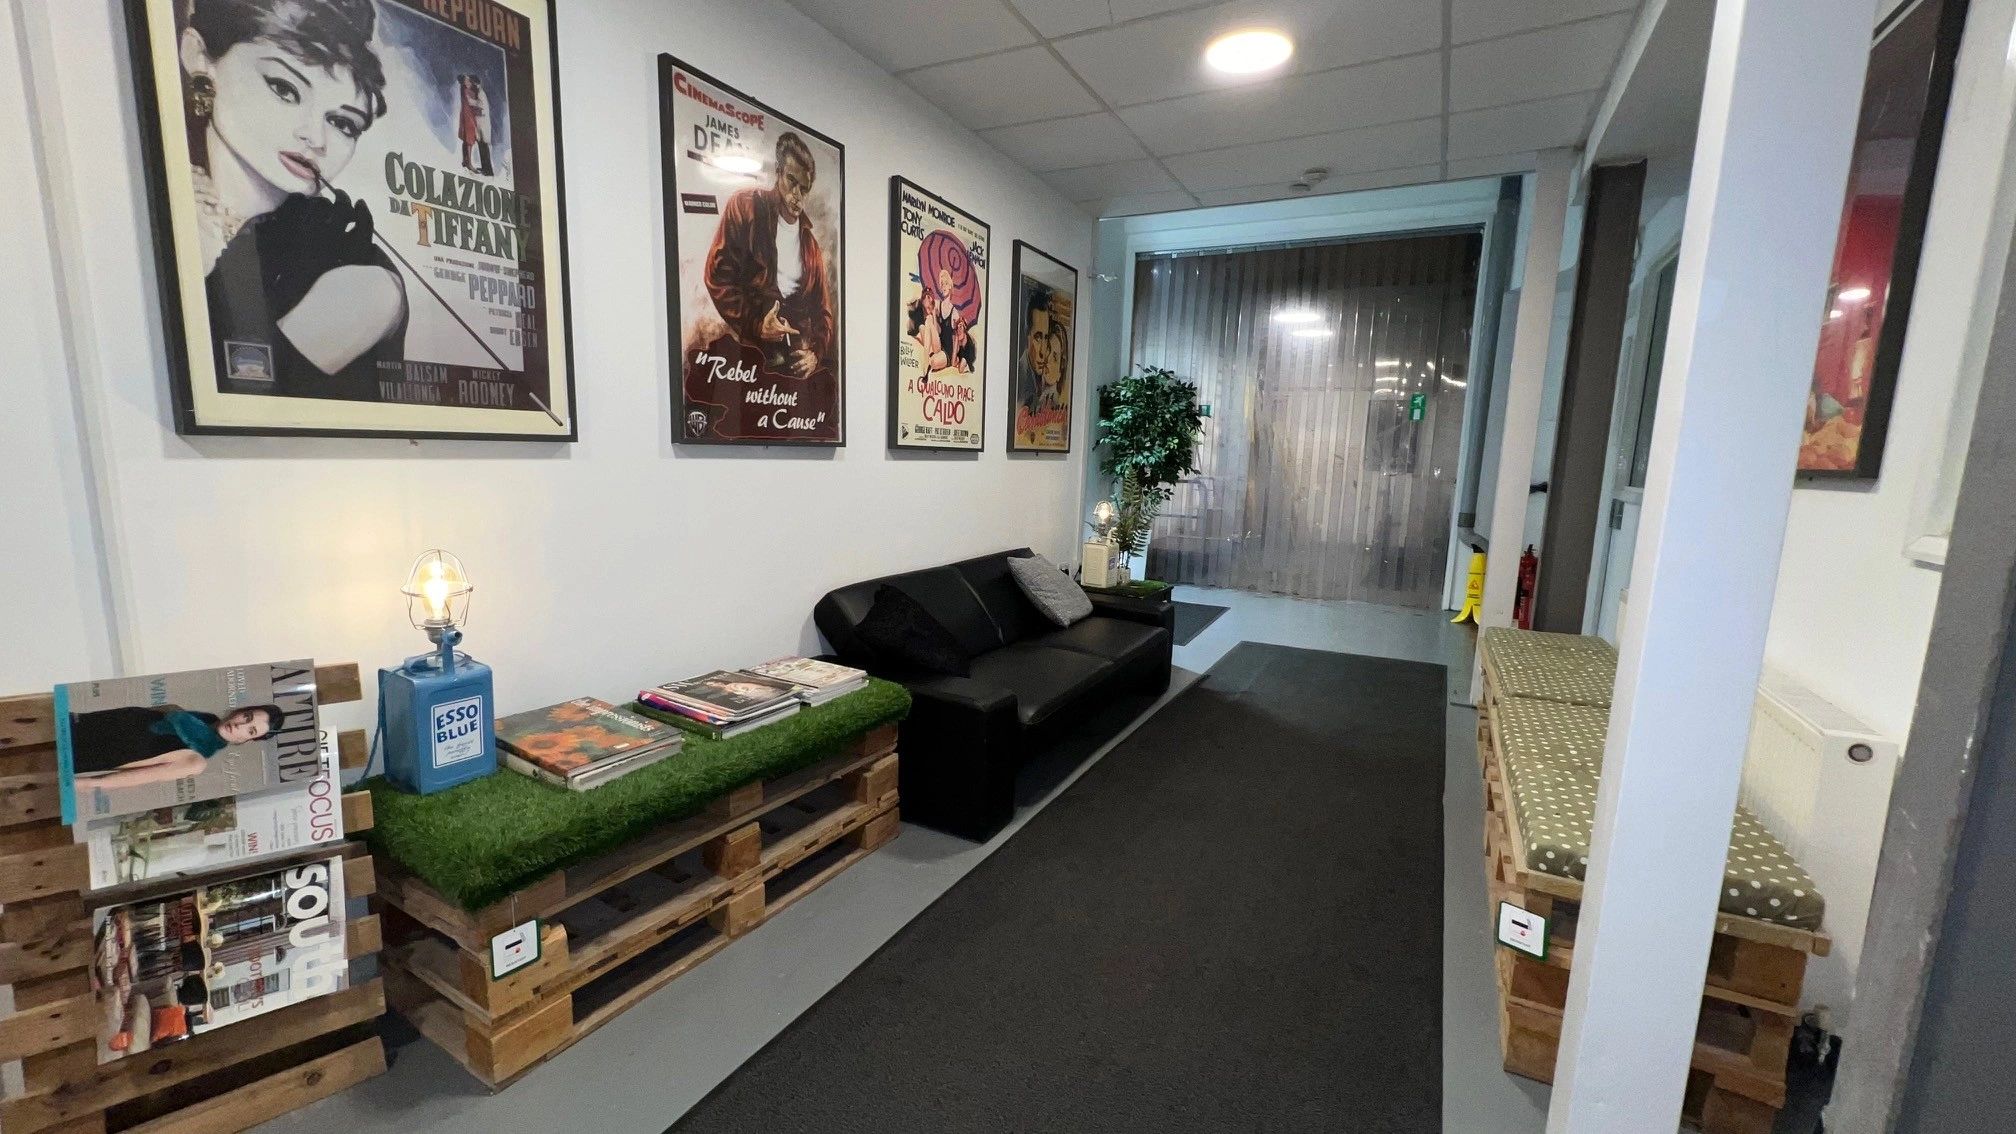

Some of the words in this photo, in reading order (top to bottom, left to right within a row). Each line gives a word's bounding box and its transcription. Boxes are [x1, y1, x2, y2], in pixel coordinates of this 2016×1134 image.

[706, 115, 740, 139] JAMES
[385, 152, 532, 227] COLAZIONE
[389, 197, 411, 217] DA
[902, 206, 922, 226] TONY
[410, 202, 529, 262] TIFFANY
[900, 221, 925, 241] CURTIS
[468, 273, 536, 309] PEPPARD
[405, 362, 448, 384] BALSAM
[458, 379, 516, 407] ROONEY
[745, 384, 798, 407] without
[907, 379, 914, 394] A
[757, 413, 768, 428] a
[922, 396, 965, 425] CALDO
[270, 664, 319, 784] ATTIRE
[436, 704, 478, 730] ESSO
[436, 719, 478, 743] BLUE
